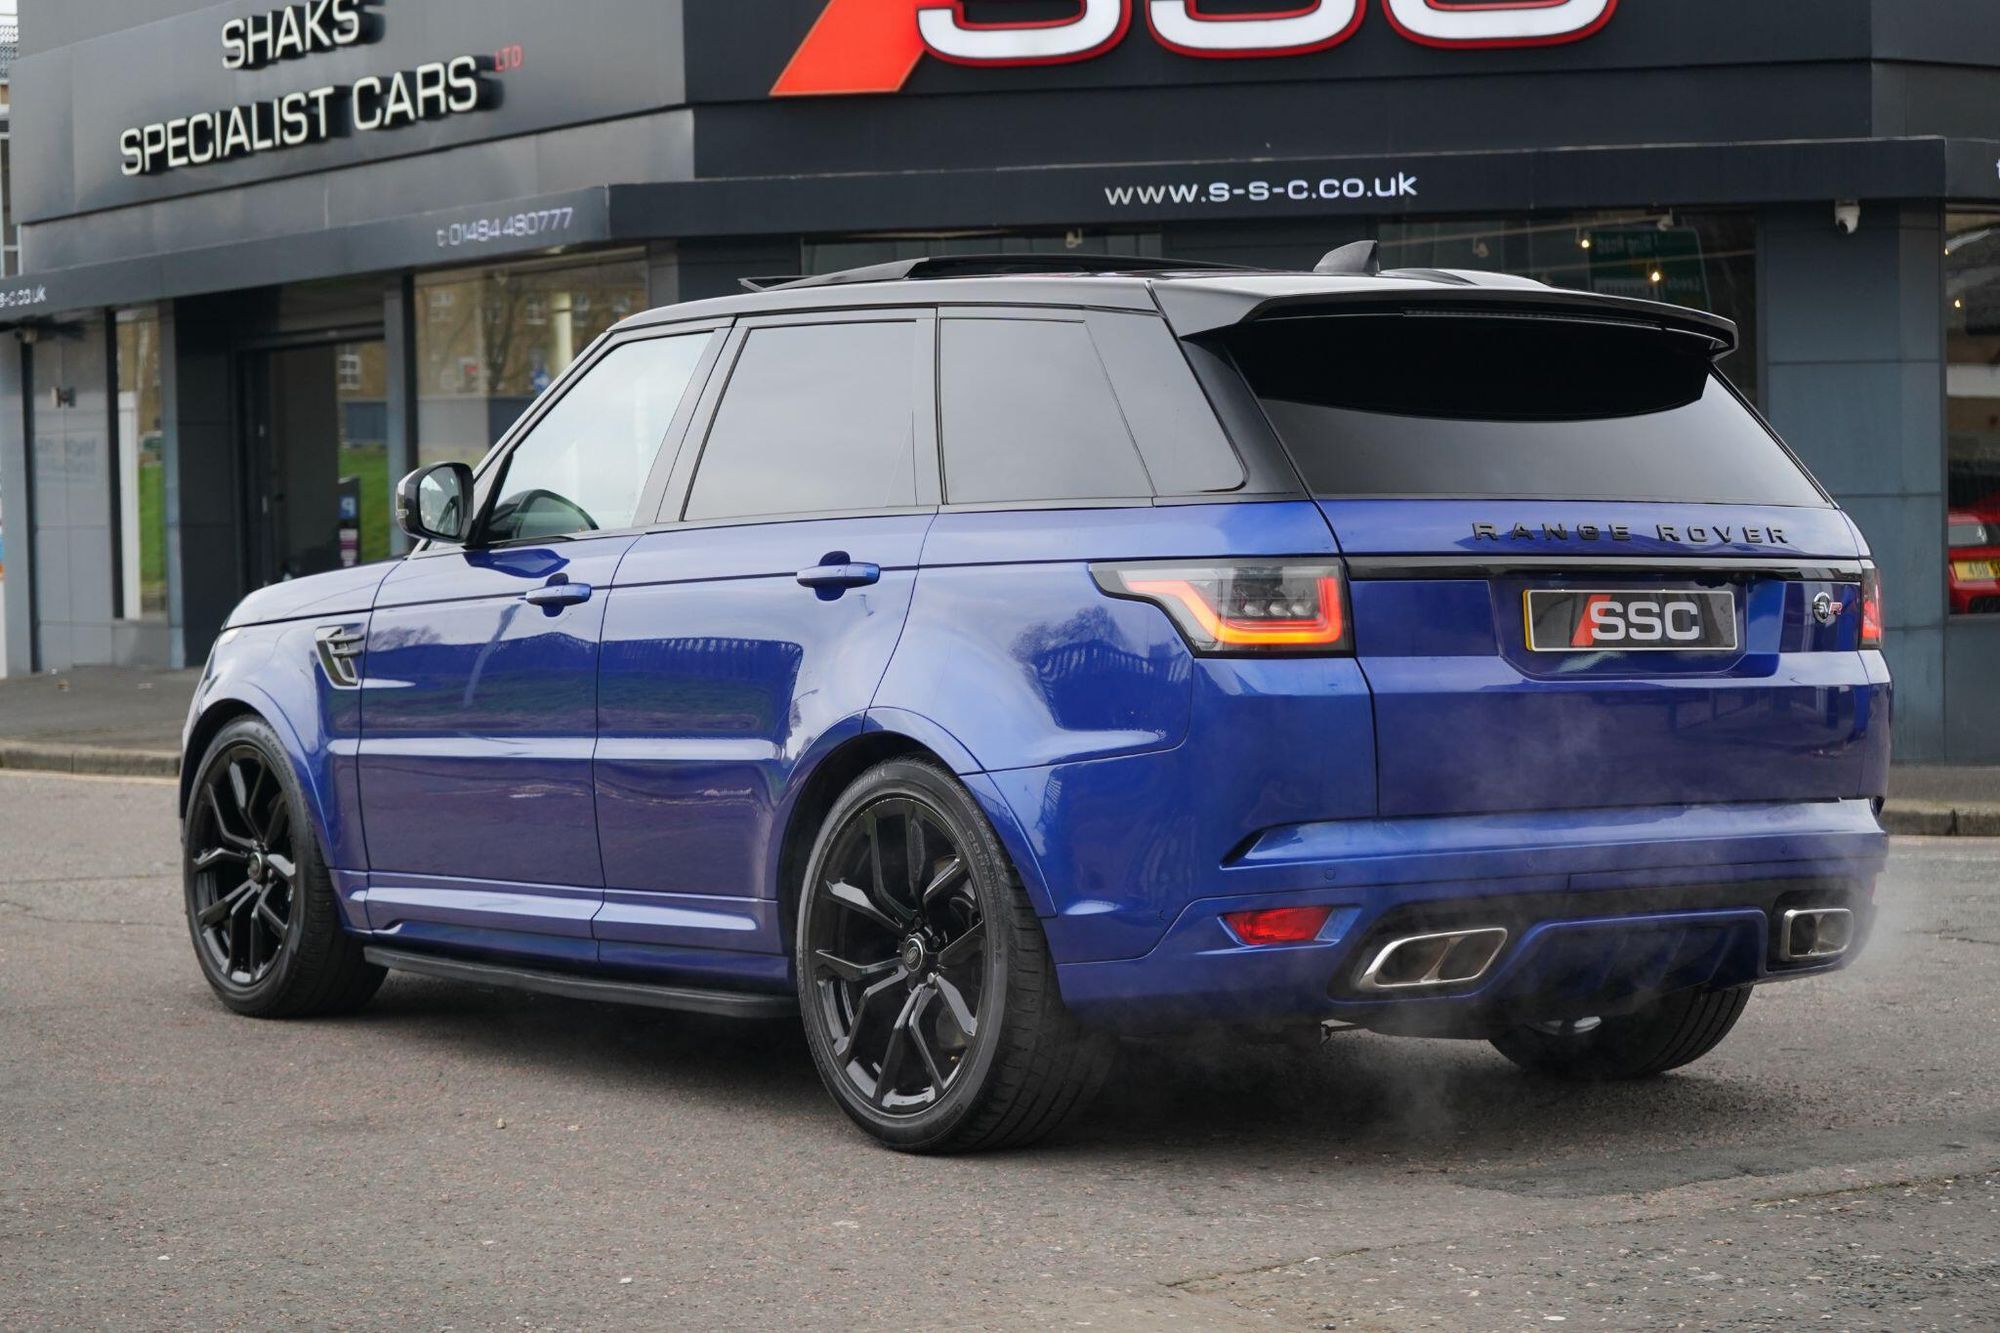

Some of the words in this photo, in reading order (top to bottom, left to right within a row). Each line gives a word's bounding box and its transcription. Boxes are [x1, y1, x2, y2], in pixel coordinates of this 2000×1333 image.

[221, 0, 360, 69] SHAKS
[119, 85, 335, 176] SPECIALIST
[352, 55, 478, 130] CARS
[494, 43, 523, 73] LTD
[1104, 171, 1418, 206] www.s-s-c.co.uk
[1471, 521, 1633, 542] RANGE
[1655, 523, 1790, 544] ROVER
[1590, 600, 1700, 641] SSC
